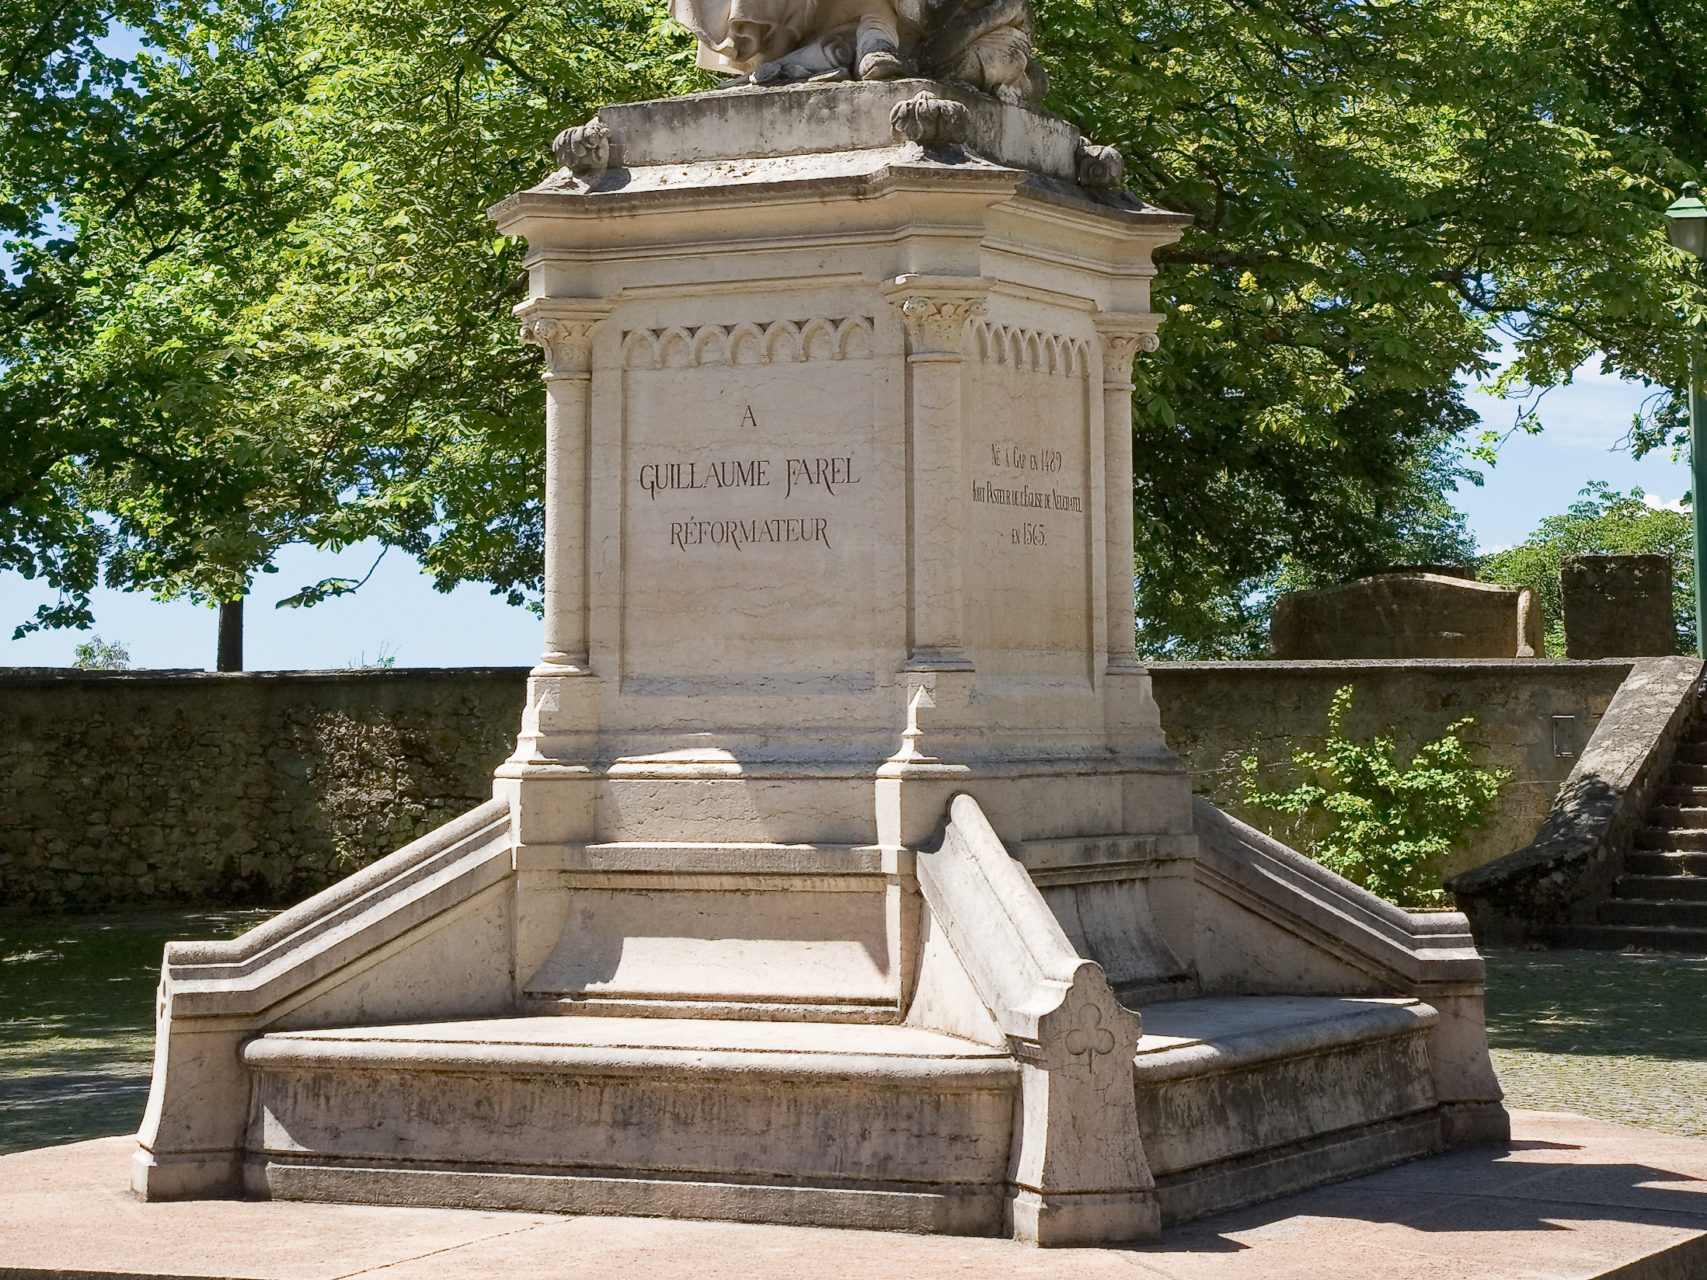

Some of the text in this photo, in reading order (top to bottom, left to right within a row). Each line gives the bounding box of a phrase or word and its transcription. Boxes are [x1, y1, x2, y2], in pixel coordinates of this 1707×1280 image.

[740, 405, 757, 428] A
[1041, 449, 1062, 473] 1489
[639, 457, 861, 501] GUILLAUME FAREL
[670, 515, 832, 552] RÉFORMATEUR
